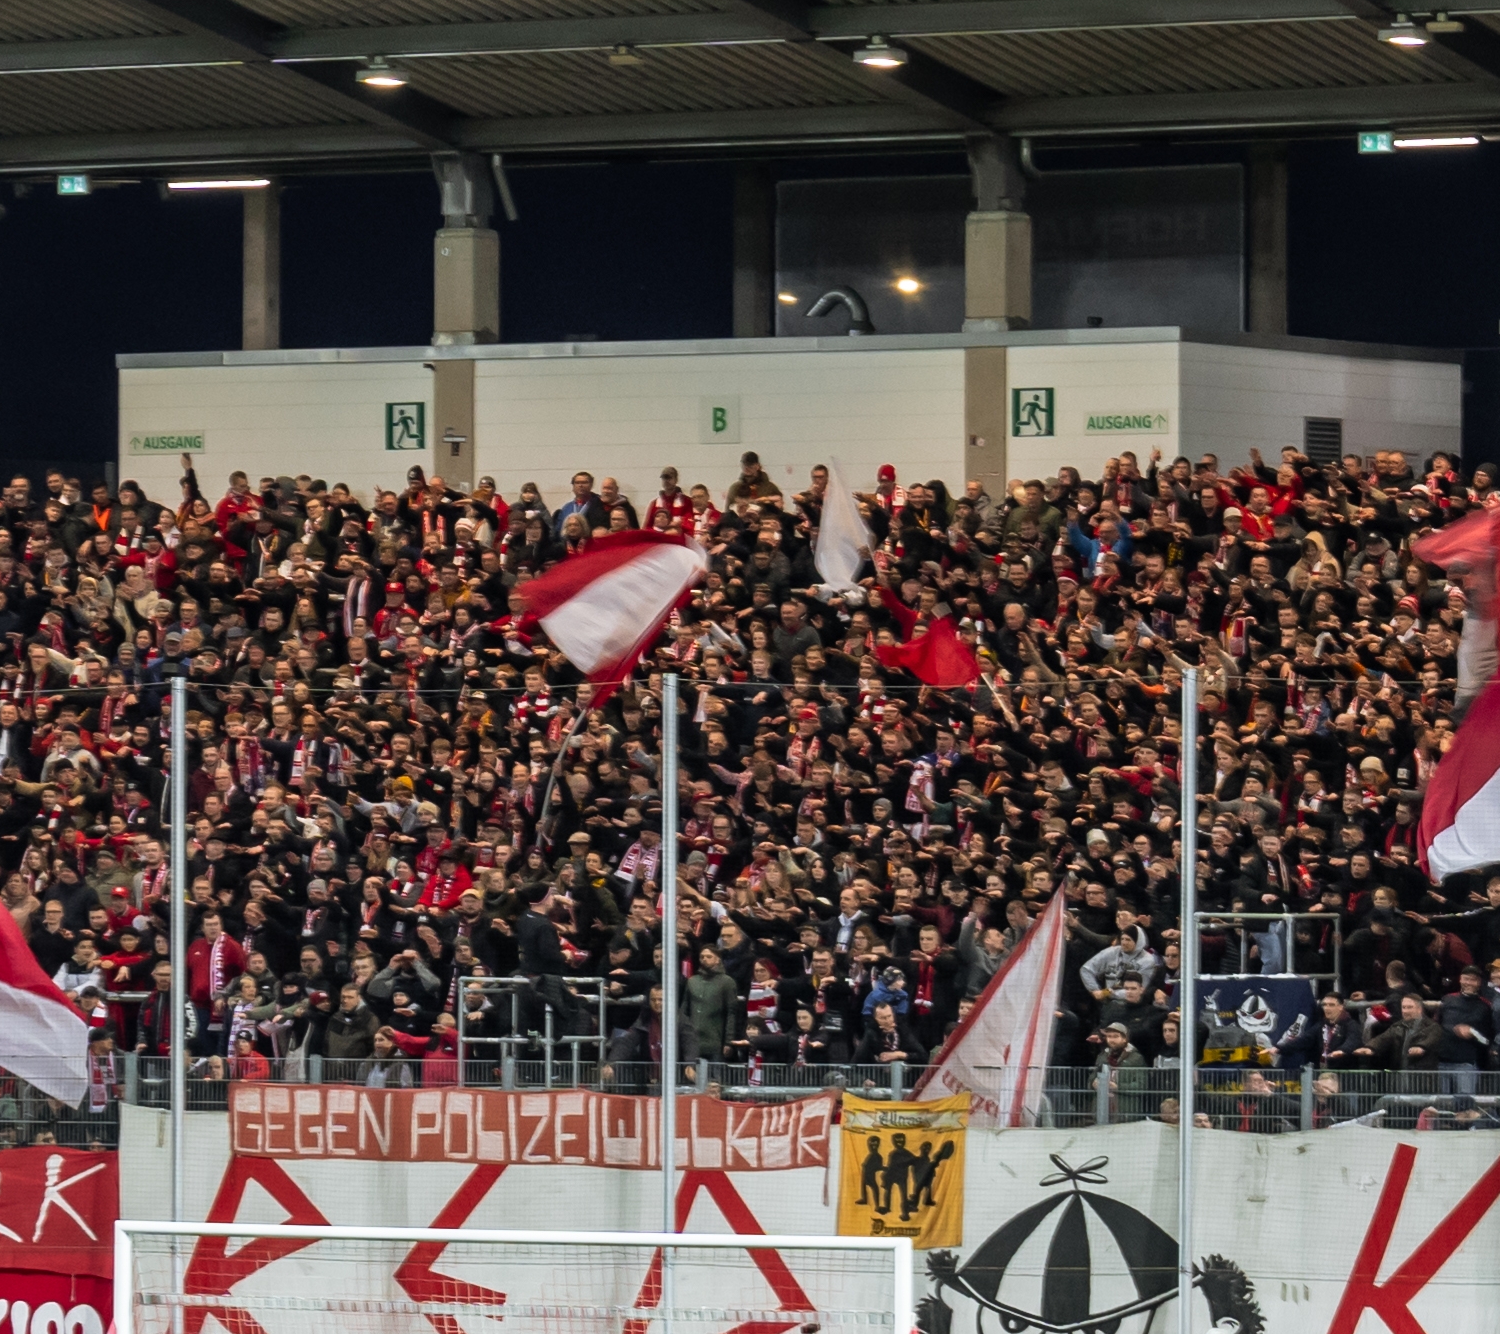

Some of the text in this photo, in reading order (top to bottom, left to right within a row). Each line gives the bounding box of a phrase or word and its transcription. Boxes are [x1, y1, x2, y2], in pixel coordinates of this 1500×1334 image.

[711, 407, 727, 434] B
[1086, 413, 1153, 431] AUSGANG
[142, 434, 203, 451] AUSGANG
[233, 1085, 393, 1159] GEGEN
